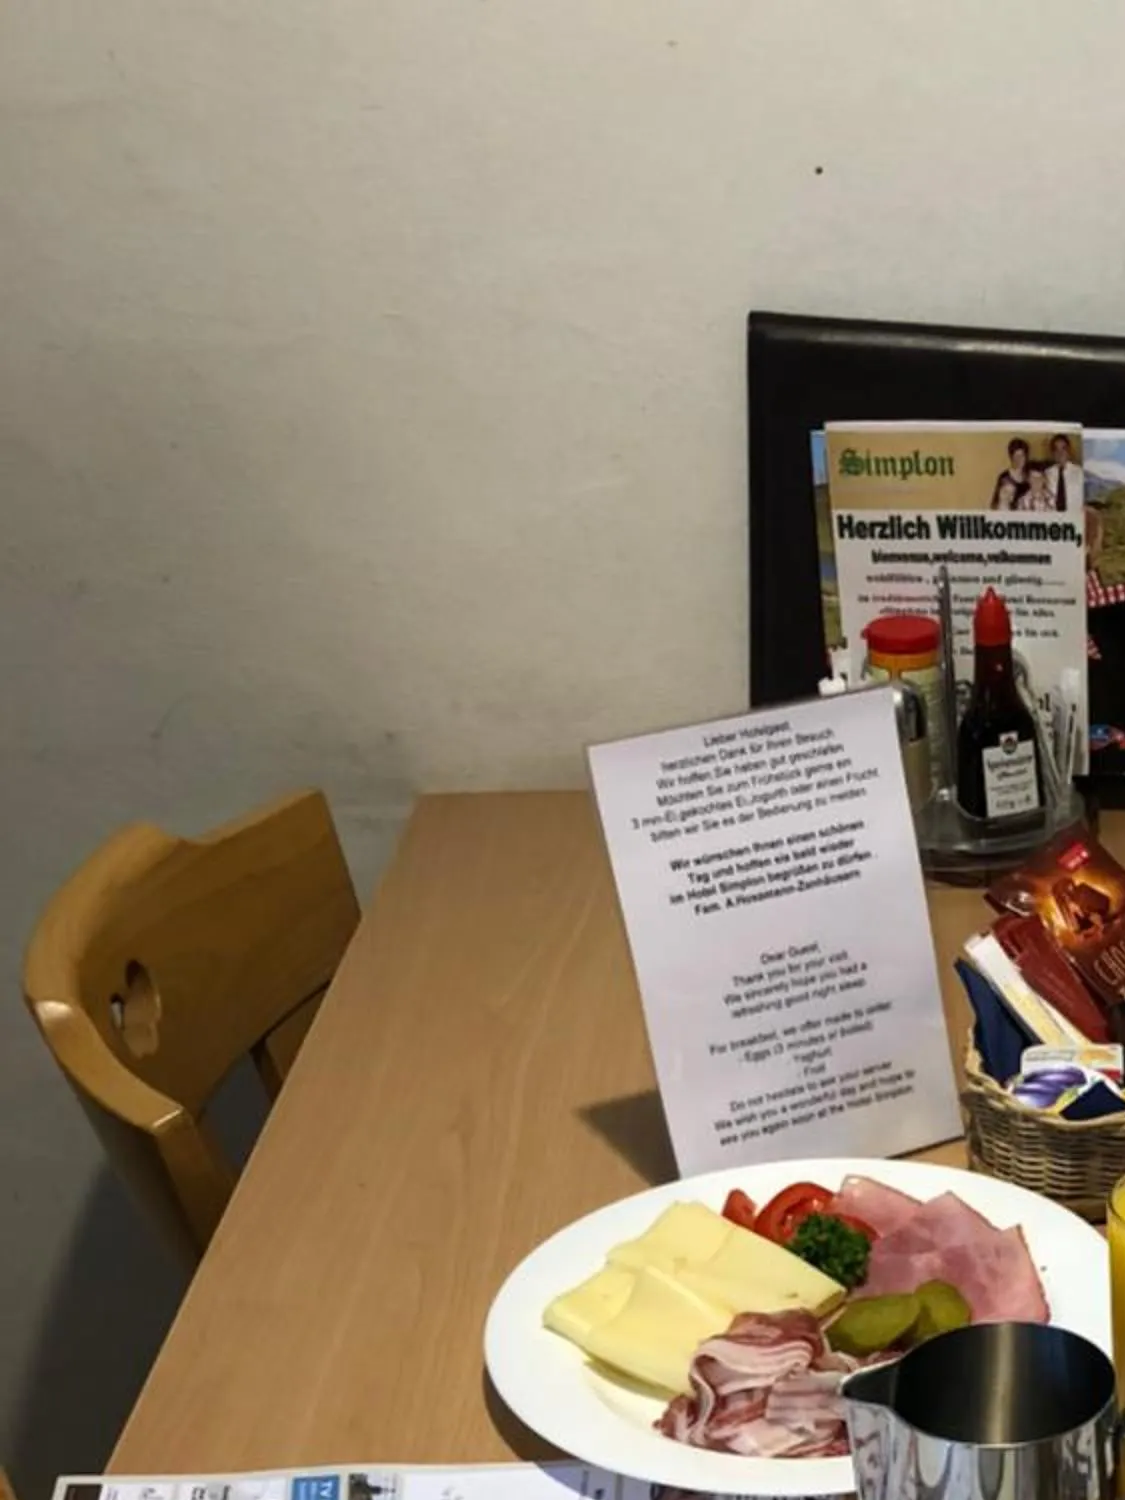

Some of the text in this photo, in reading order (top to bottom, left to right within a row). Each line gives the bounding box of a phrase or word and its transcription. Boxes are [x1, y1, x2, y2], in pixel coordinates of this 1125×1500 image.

[839, 447, 955, 479] Simplon
[838, 514, 1083, 547] Herzlich Willkommen,
[718, 747, 747, 760] Dank
[656, 778, 675, 789] Wir
[713, 766, 731, 778] Sie
[733, 759, 766, 773] haben
[769, 754, 786, 769] gut
[705, 784, 724, 796] Sie
[701, 819, 720, 830] Sie
[669, 859, 690, 871] Wir
[687, 872, 710, 883] Tag
[711, 864, 734, 878] und
[735, 858, 771, 872] hoffen
[791, 845, 816, 860] bald
[686, 885, 716, 900] Hotel
[759, 951, 785, 964] Dear
[732, 972, 764, 986] Thank
[766, 967, 786, 982] you
[786, 963, 801, 973] for
[804, 957, 825, 972] your
[723, 993, 742, 1005] We
[790, 975, 816, 986] hope
[818, 970, 837, 983] you
[838, 962, 858, 975] had
[860, 961, 867, 970] a
[784, 991, 809, 1008] good
[708, 1044, 727, 1055] For
[782, 1026, 797, 1036] we
[743, 1048, 771, 1062] Eggs
[729, 1100, 746, 1112] Do
[746, 1095, 763, 1106] not
[838, 1069, 860, 1083] your
[714, 1119, 732, 1131] We
[734, 1112, 757, 1126] wish
[759, 1108, 778, 1120] you
[780, 1105, 787, 1113] a
[740, 1129, 760, 1141] you
